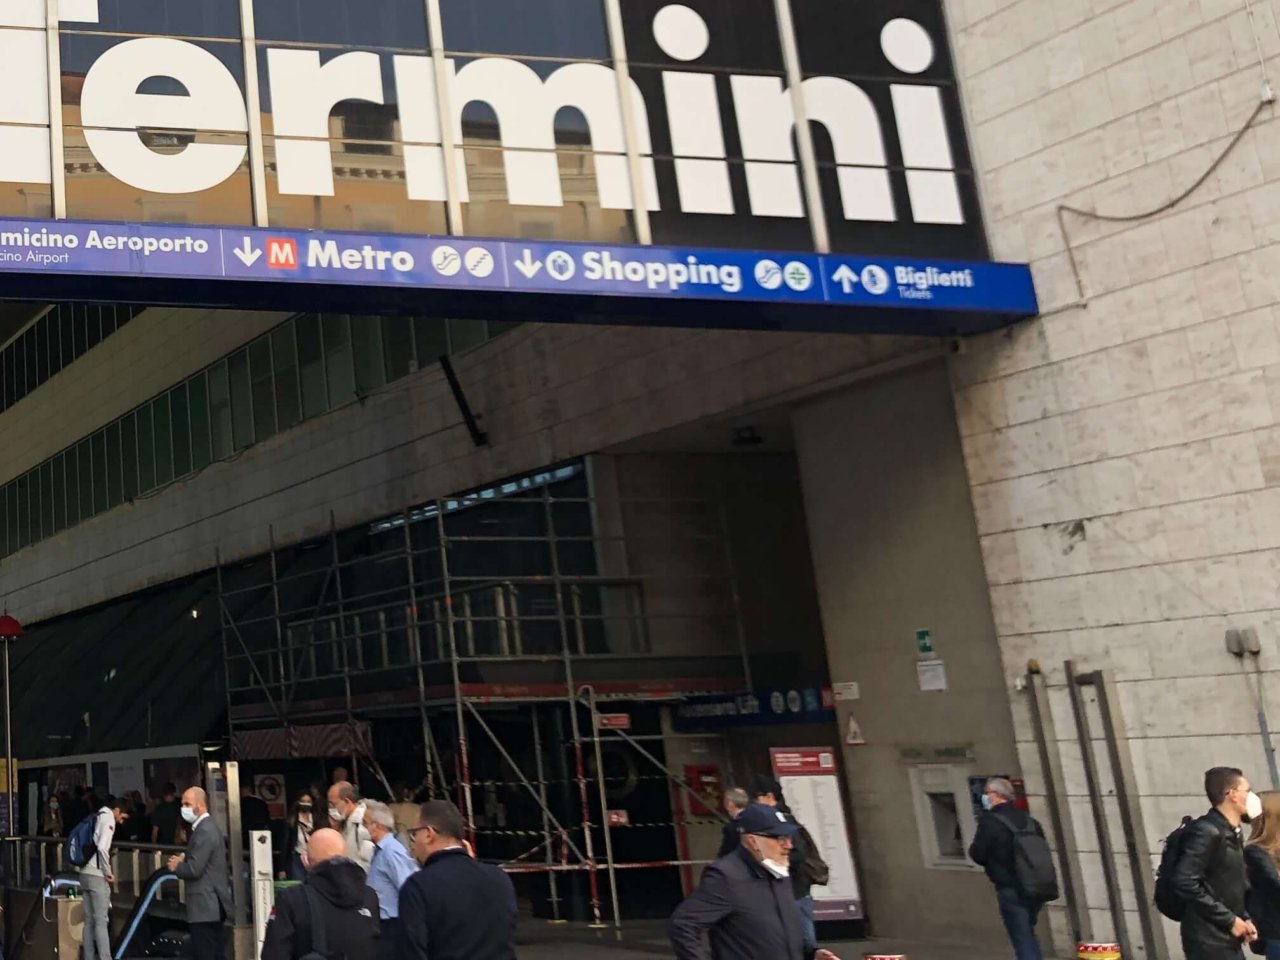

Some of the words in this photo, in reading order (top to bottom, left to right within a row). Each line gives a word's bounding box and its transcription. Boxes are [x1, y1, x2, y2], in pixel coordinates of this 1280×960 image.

[85, 230, 209, 256] Aeroporto
[307, 240, 415, 271] Metro
[26, 250, 69, 265] Airport
[583, 251, 742, 292] Shopping
[894, 265, 975, 289] Biglietti
